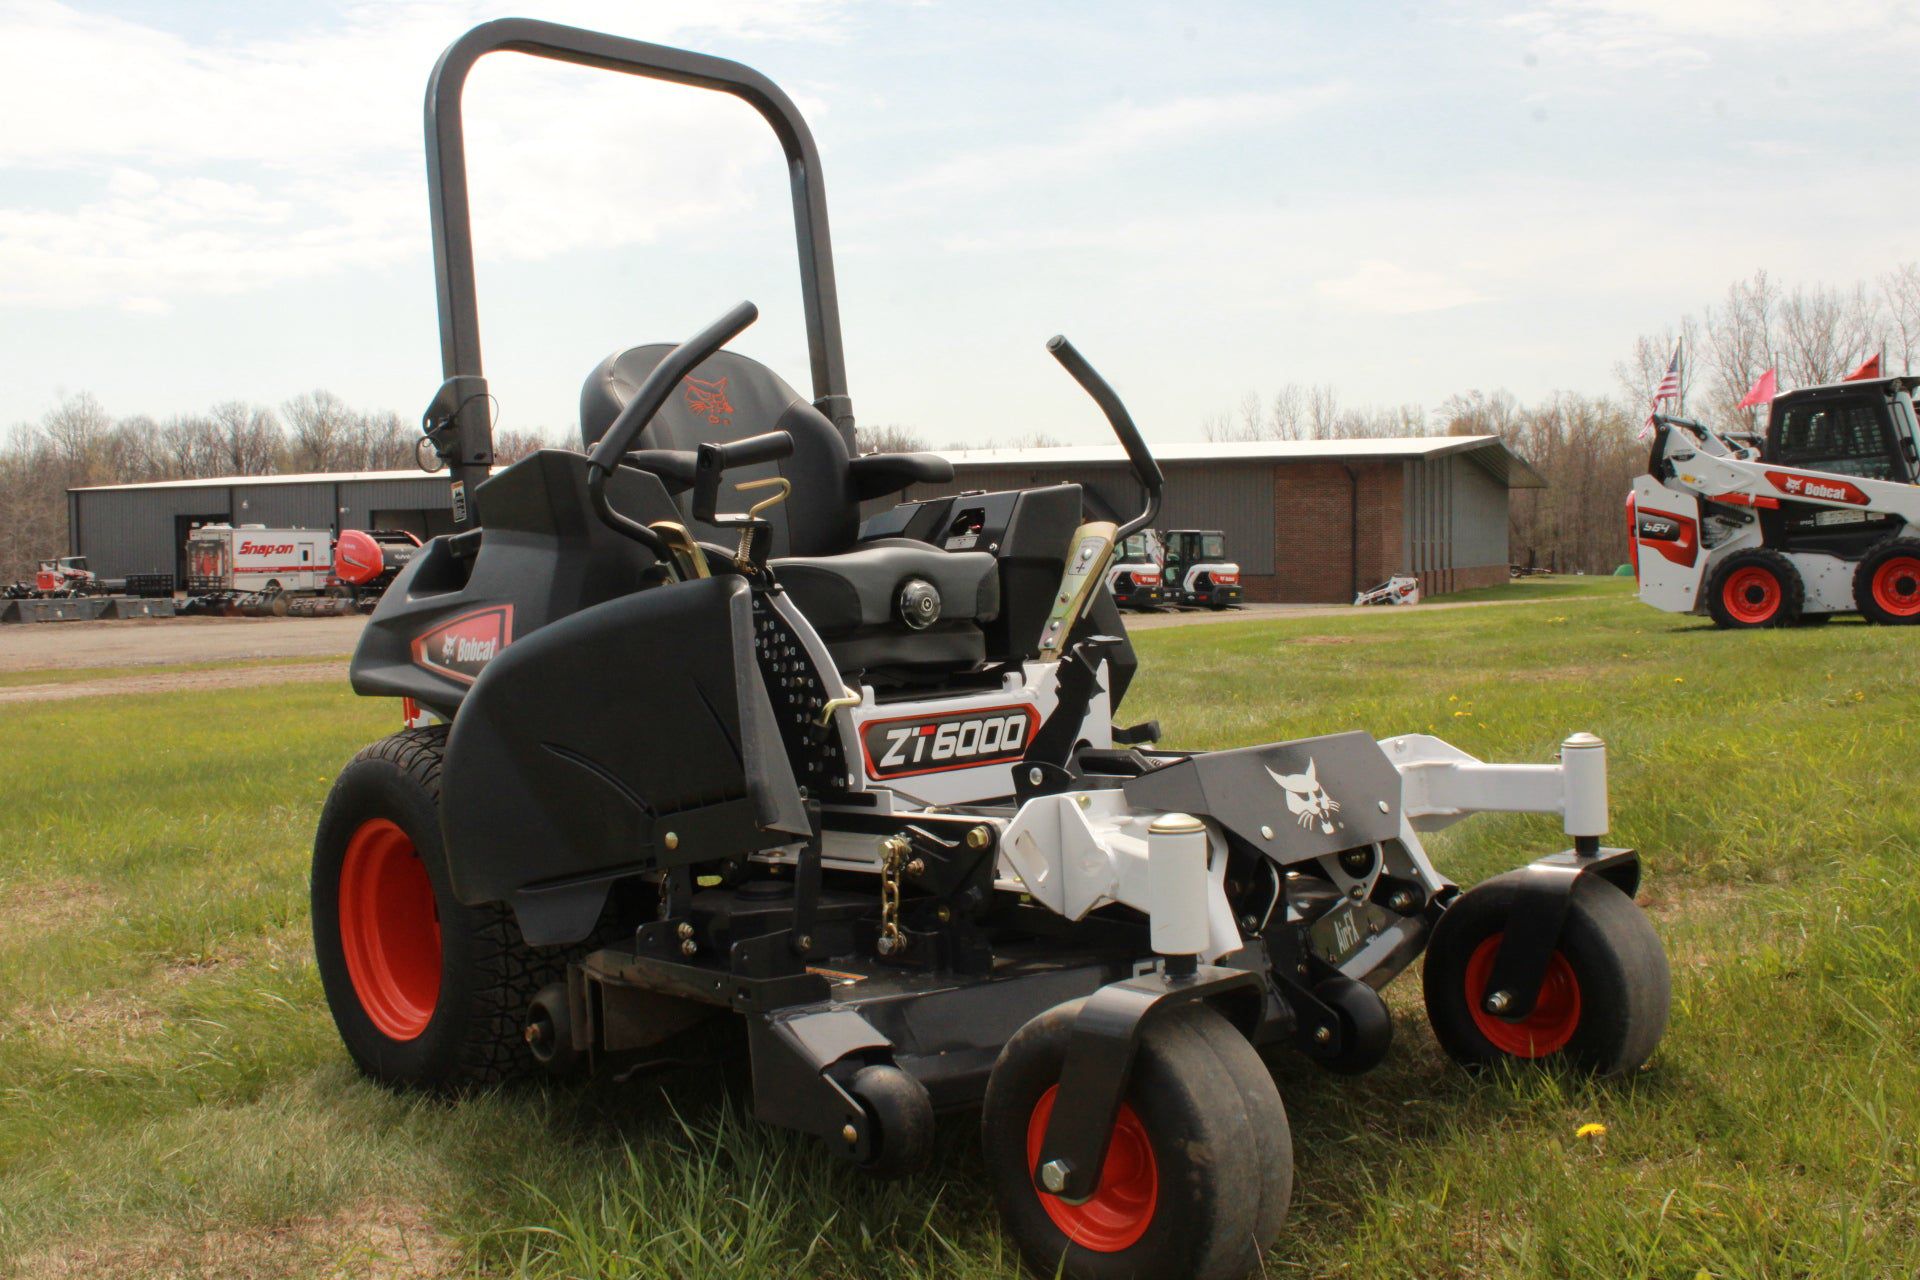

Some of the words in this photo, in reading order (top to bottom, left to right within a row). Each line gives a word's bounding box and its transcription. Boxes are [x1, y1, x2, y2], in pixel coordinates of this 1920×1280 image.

[1804, 482, 1846, 500] Bobcat
[238, 541, 294, 557] Snap-on
[457, 637, 497, 662] Bobcat
[879, 714, 1027, 768] ZT6000
